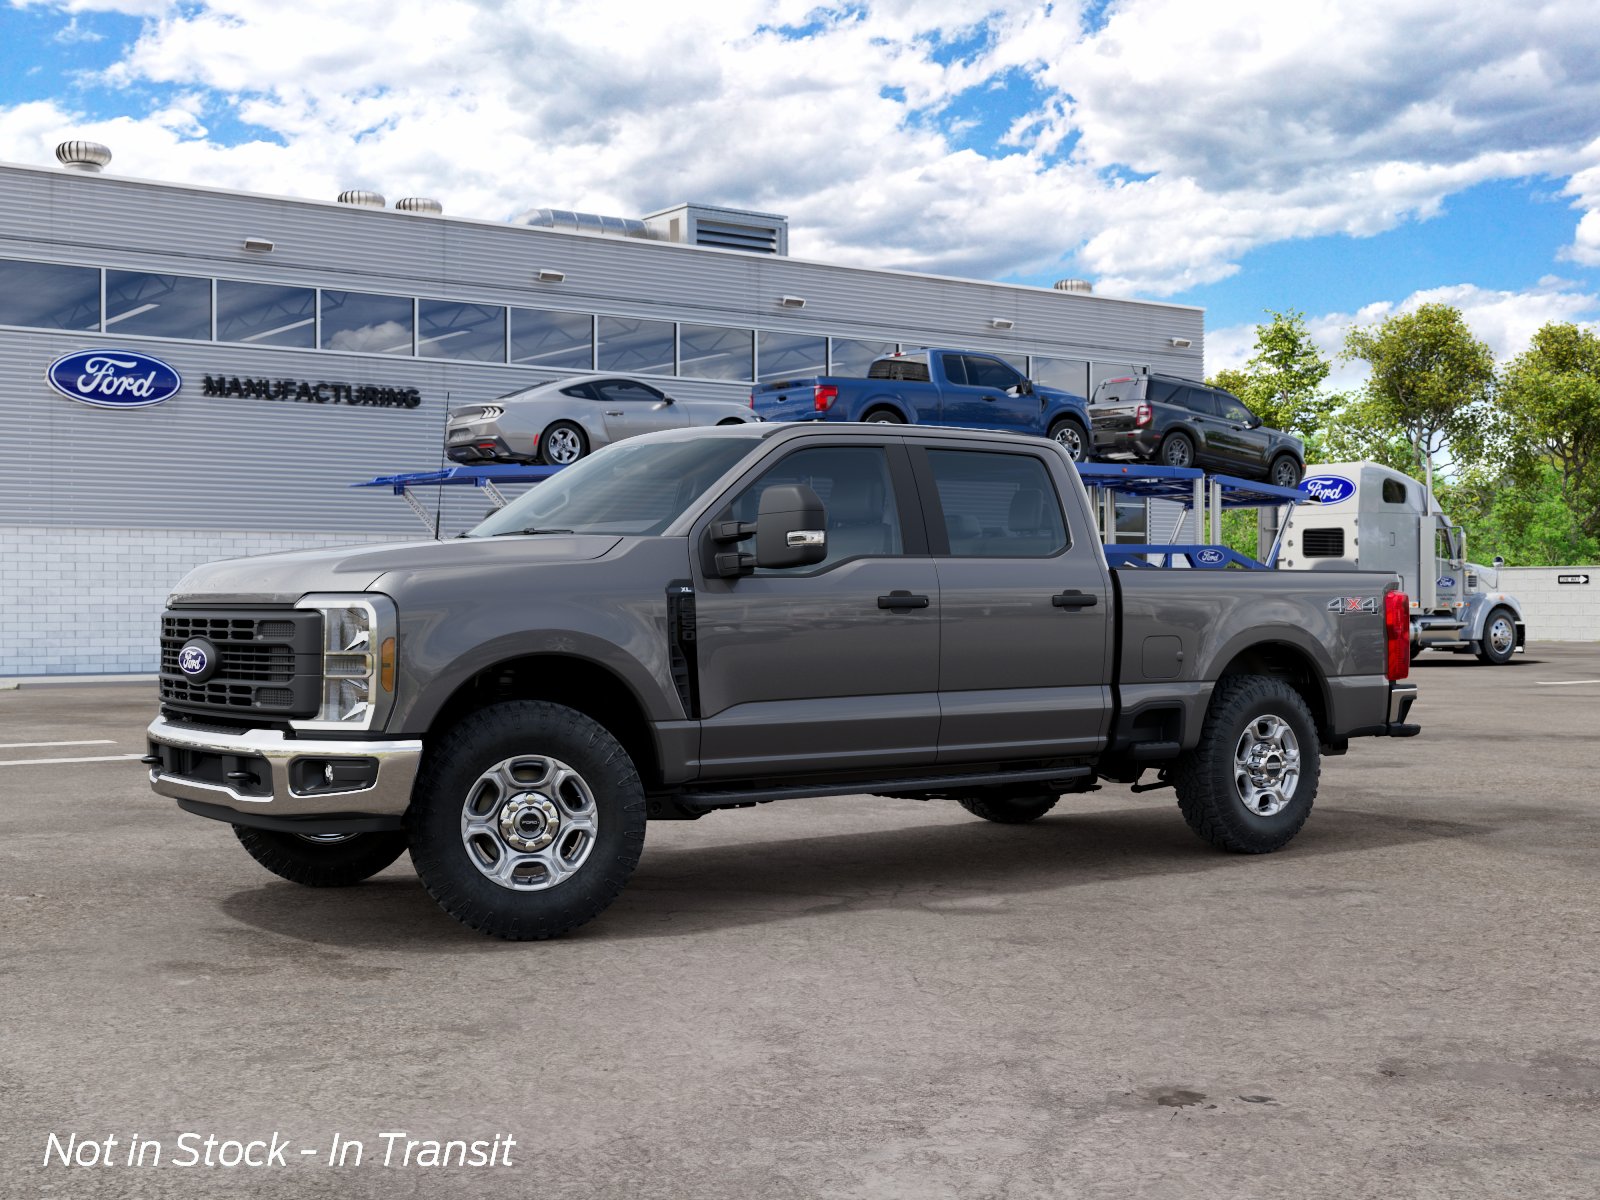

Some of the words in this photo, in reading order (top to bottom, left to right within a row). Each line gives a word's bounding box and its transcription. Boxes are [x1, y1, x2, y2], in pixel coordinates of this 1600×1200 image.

[76, 356, 157, 399] Ford
[204, 375, 421, 409] MANUFACTURING
[1305, 479, 1344, 500] Ford
[1201, 550, 1220, 562] Ford
[182, 649, 202, 670] Ford
